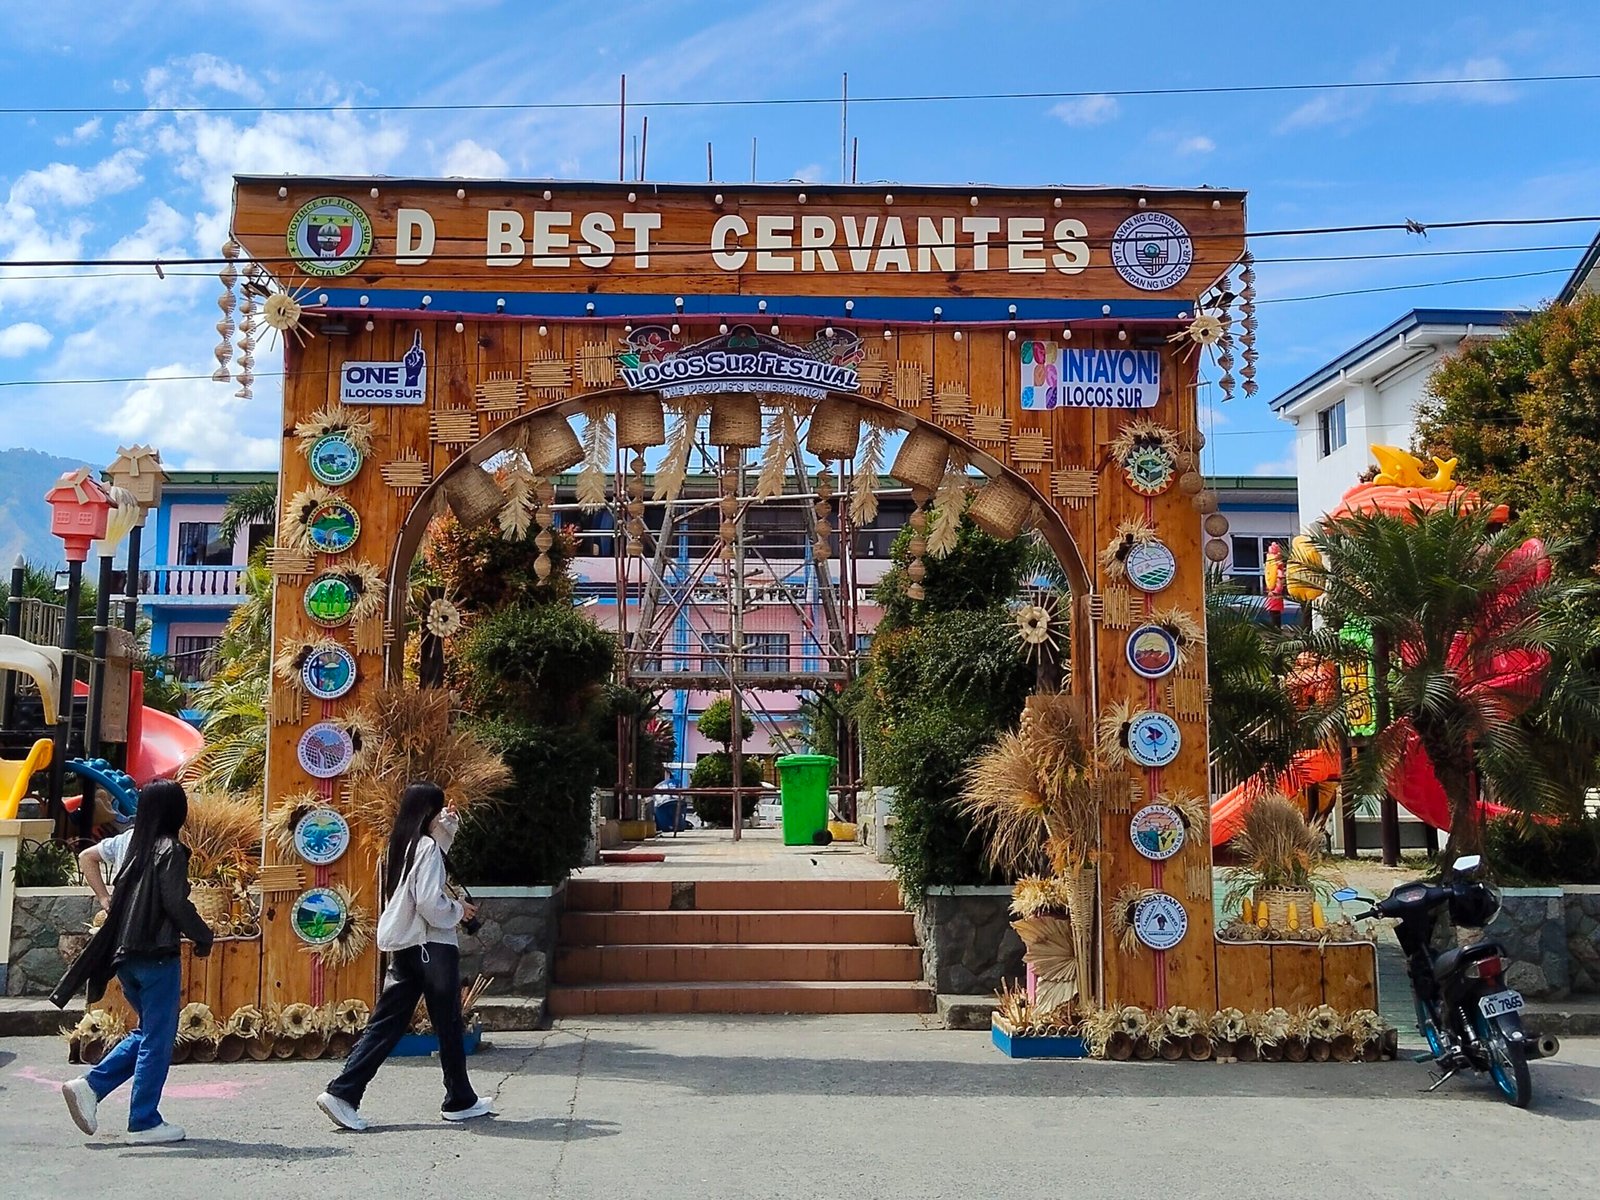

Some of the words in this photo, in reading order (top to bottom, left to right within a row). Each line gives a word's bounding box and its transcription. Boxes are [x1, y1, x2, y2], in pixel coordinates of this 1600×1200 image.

[289, 200, 318, 241] PROVINCE
[336, 199, 367, 224] ILOCOS
[1132, 214, 1145, 224] NG
[396, 209, 435, 265] D
[486, 210, 661, 268] BEST
[711, 215, 1090, 274] CERVANTES
[1160, 265, 1185, 286] ILOCOS
[346, 366, 399, 384] ONE
[623, 357, 703, 386] ILOCOS
[707, 351, 757, 375] SUR
[758, 352, 862, 390] FESTIVAL
[1062, 348, 1158, 384] INTAYON!
[345, 389, 393, 398] ILOCOS
[395, 389, 422, 398] SUR
[1062, 386, 1114, 407] ILOCOS
[1117, 388, 1142, 407] SUR
[1135, 895, 1161, 922] BARANGAY
[1163, 895, 1178, 906] SAN
[1176, 905, 1185, 922] LUIS
